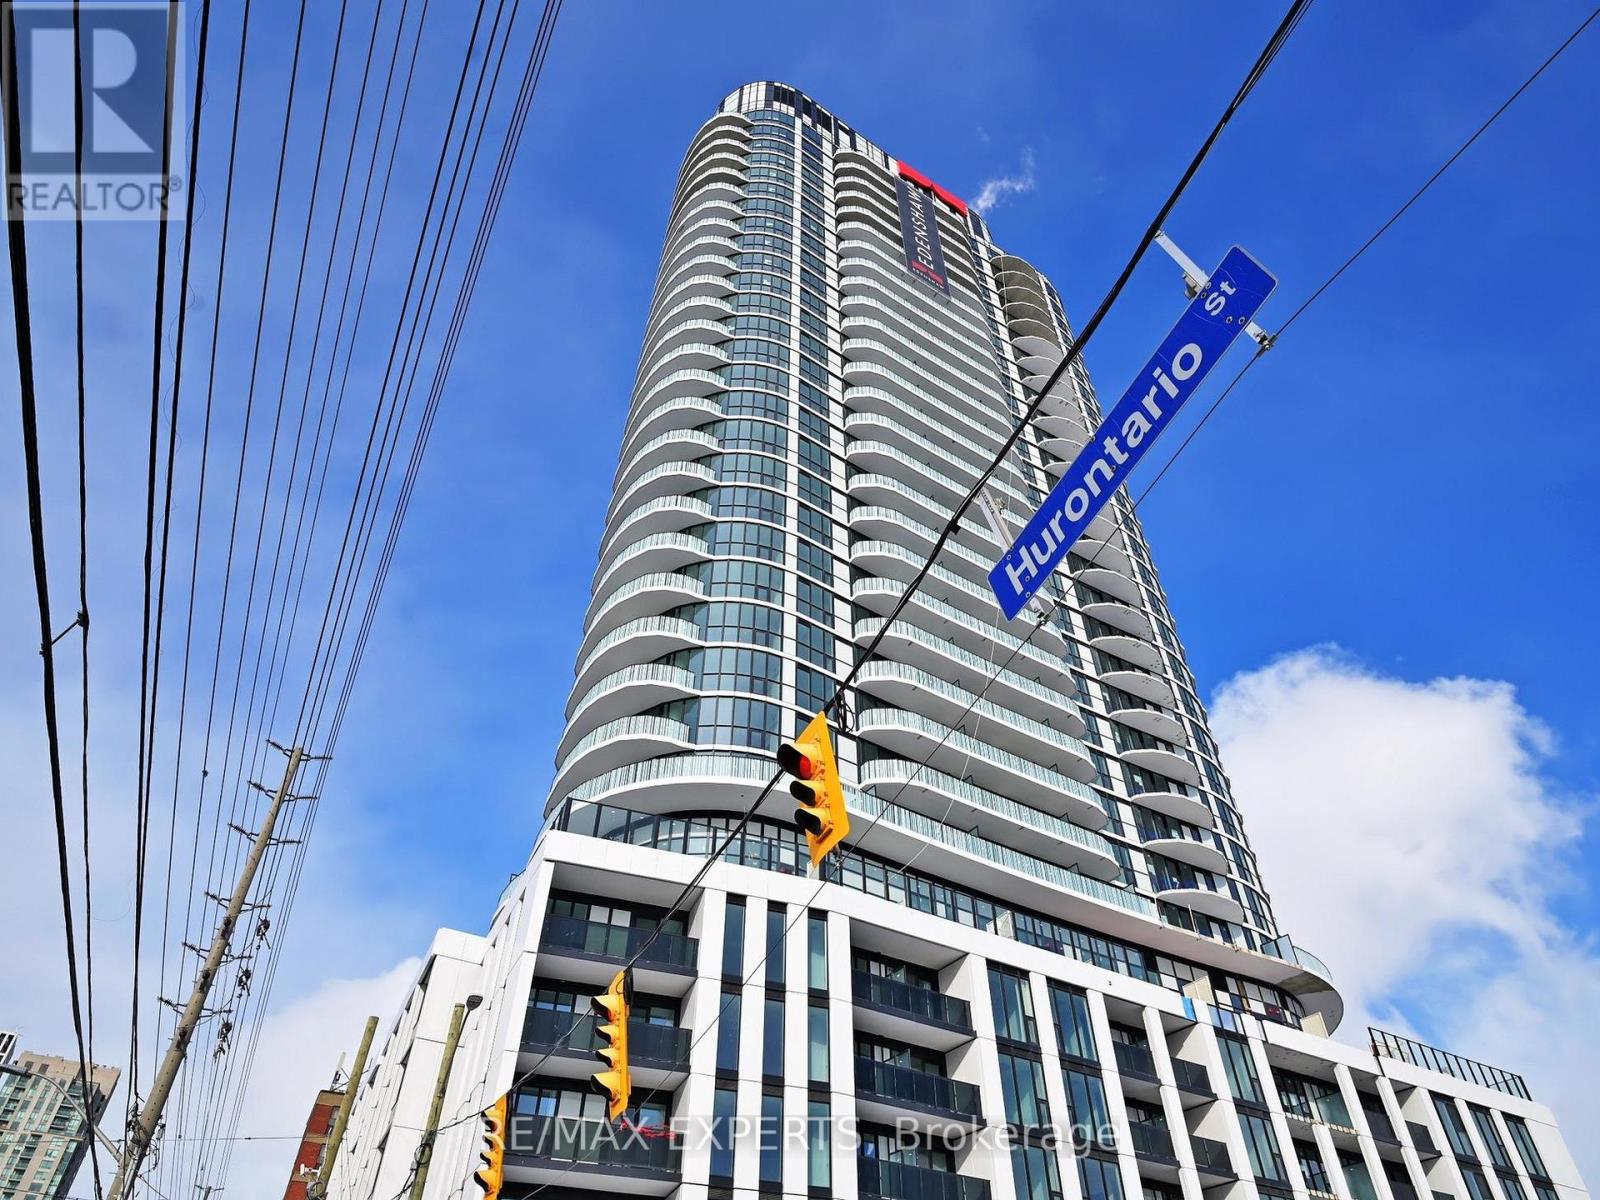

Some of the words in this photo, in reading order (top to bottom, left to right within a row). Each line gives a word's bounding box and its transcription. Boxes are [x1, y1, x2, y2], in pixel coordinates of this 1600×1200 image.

[907, 185, 934, 270] EDENSHAW
[1004, 343, 1203, 596] Hurontario
[1204, 280, 1236, 316] St
